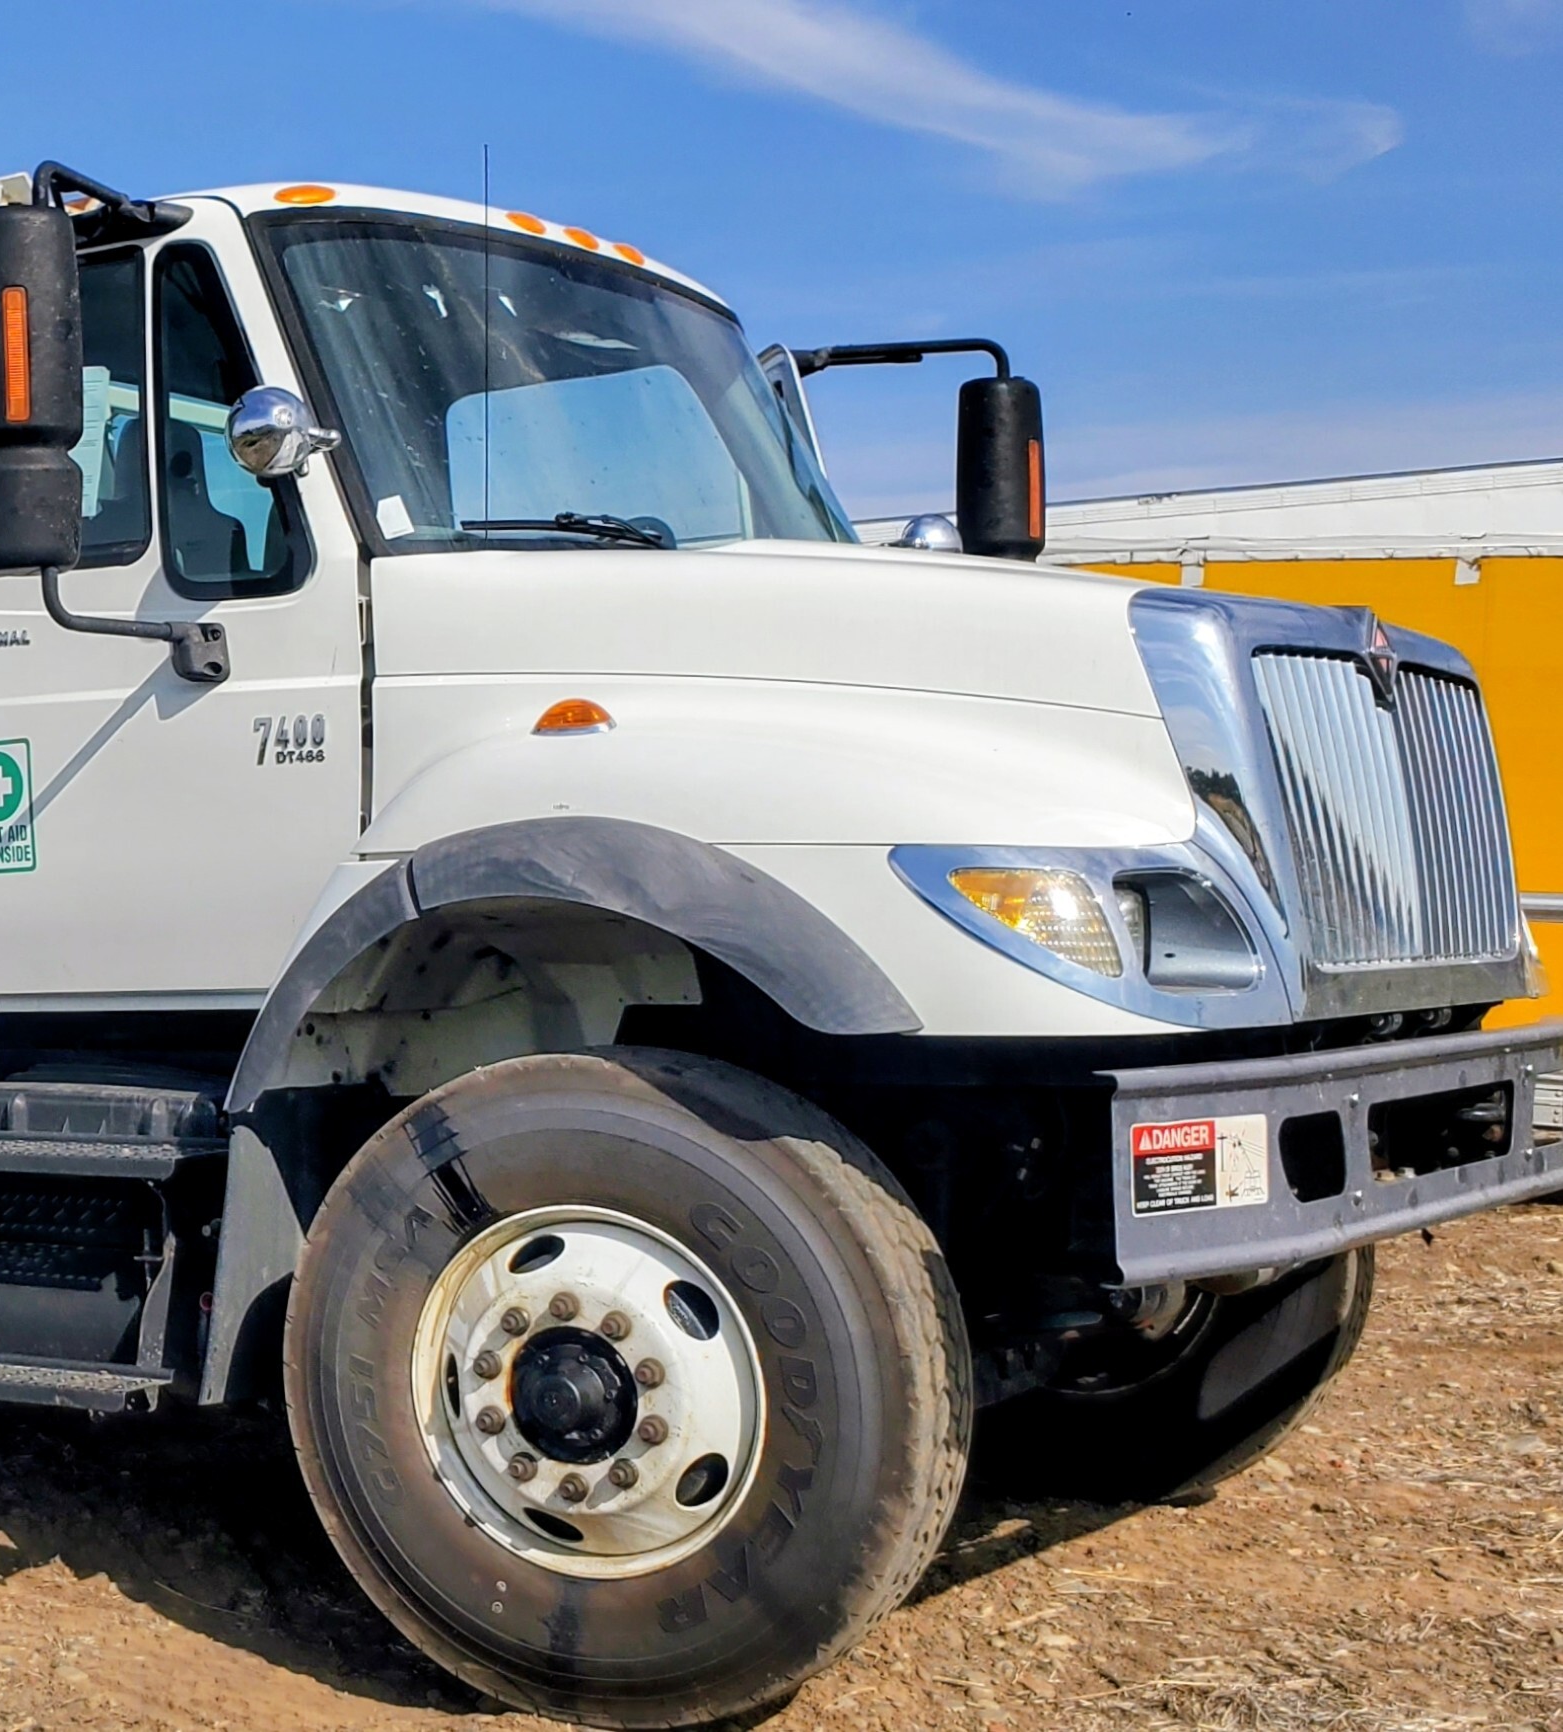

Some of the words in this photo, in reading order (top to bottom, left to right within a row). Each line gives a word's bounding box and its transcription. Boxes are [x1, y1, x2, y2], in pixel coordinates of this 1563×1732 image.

[252, 713, 325, 766] 7400
[7, 824, 28, 843] AID
[1152, 1125, 1209, 1150] DANGER
[656, 1200, 824, 1635] GOODYEAR
